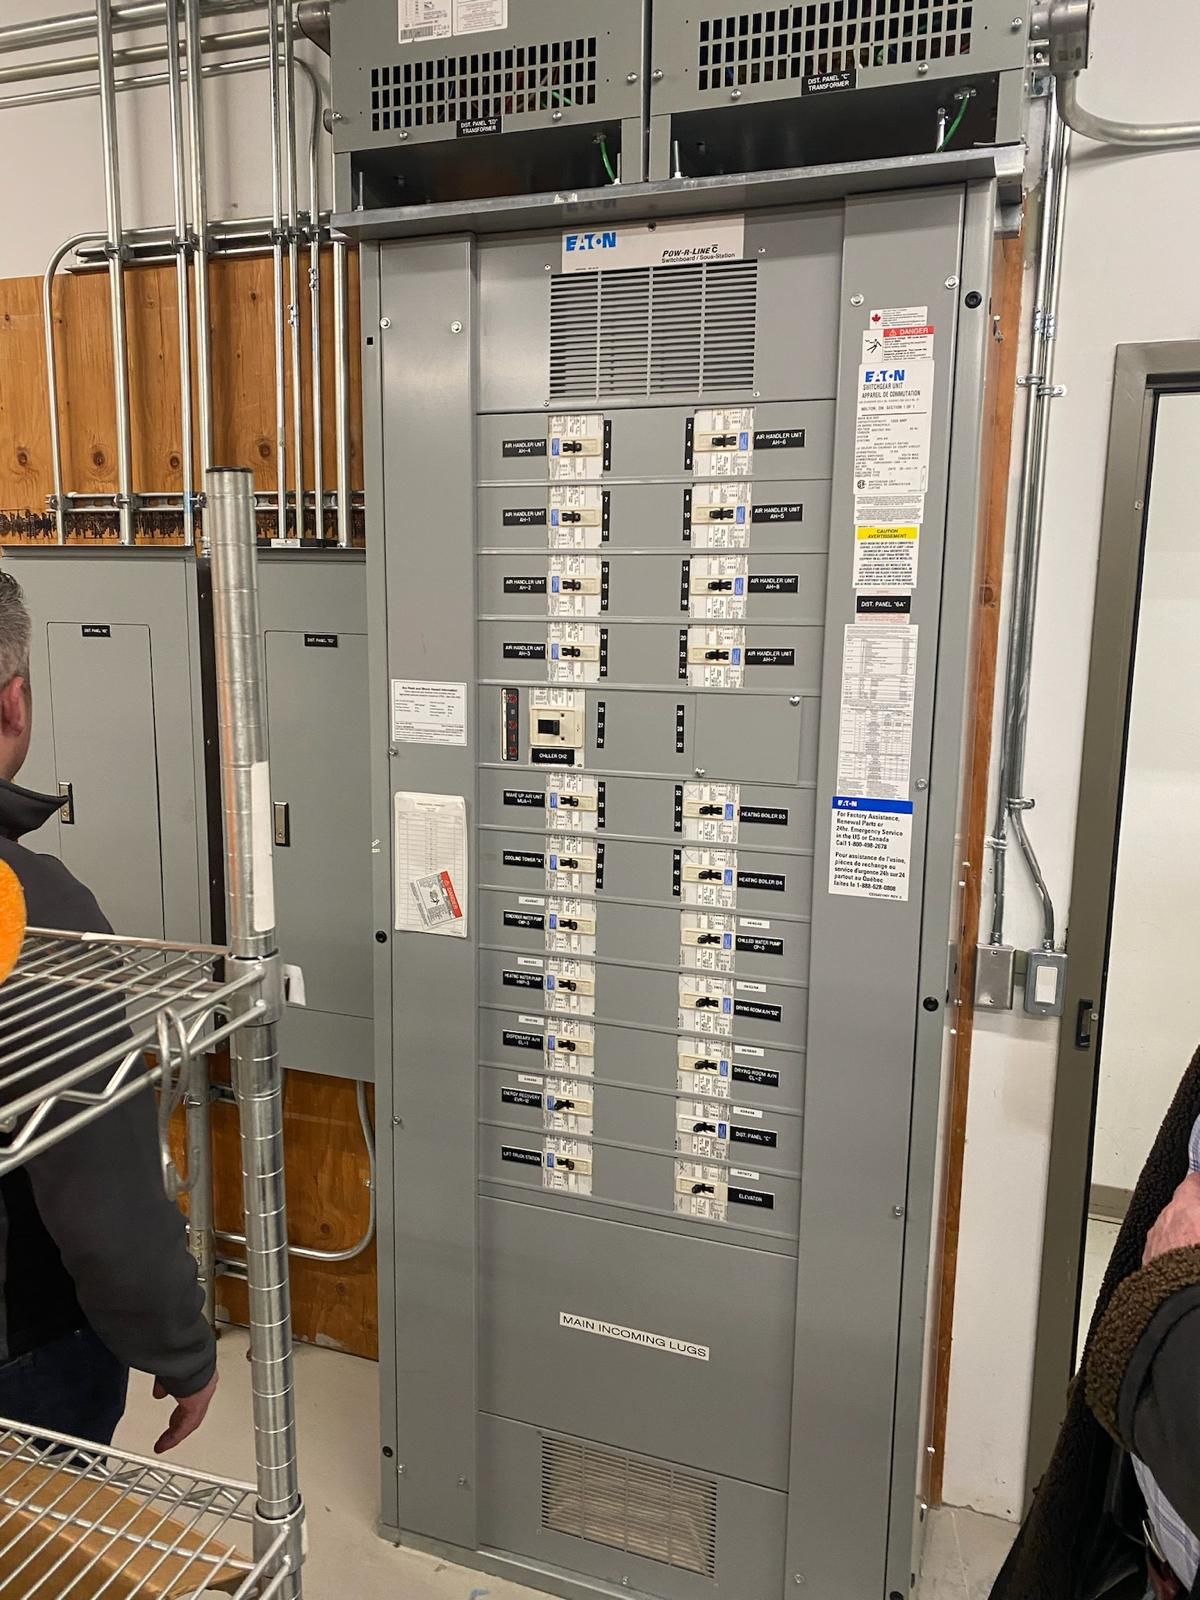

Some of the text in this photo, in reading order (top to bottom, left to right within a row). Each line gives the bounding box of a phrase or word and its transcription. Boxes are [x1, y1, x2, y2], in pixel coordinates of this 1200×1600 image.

[822, 75, 840, 83] PANEL
[808, 80, 850, 91] TRANSFORMER
[462, 125, 497, 135] TRANSFORMER
[662, 246, 711, 258] POW-R-LINE
[661, 253, 696, 264] Switchboard
[700, 252, 736, 261] Sous-Station
[899, 327, 929, 337] DANGER
[862, 383, 892, 391] SWITCHGEAR
[861, 391, 881, 399] APPAREIL
[846, 811, 867, 820] Factory
[861, 819, 876, 827] Parts
[850, 826, 881, 835] Emergency
[849, 853, 877, 861] assistance
[861, 861, 888, 870] rechange
[833, 879, 849, 887] faites
[734, 1067, 751, 1075] DRYING
[751, 1069, 766, 1077] ROOM
[738, 1193, 763, 1202] ELEVATOR
[563, 1314, 707, 1358] MAIN INCOMING LUGS
